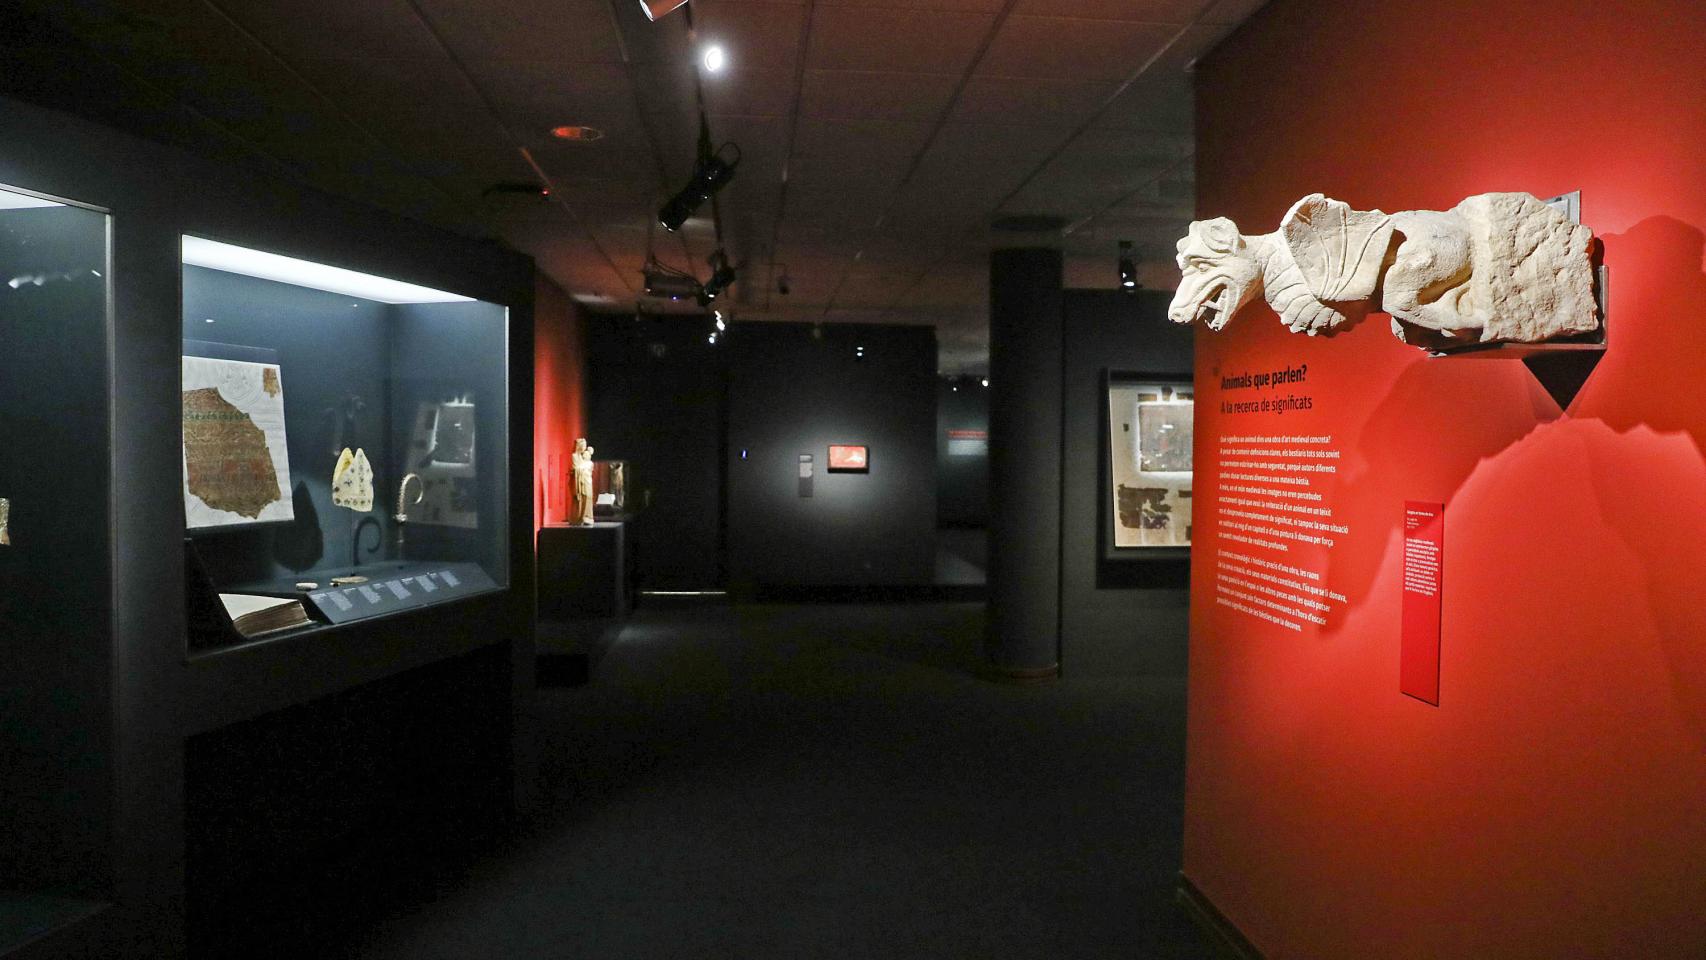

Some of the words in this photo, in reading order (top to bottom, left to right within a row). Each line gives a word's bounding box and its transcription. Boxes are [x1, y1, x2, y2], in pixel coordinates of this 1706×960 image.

[1221, 372, 1252, 390] Animals
[1254, 374, 1270, 390] que
[1272, 364, 1307, 389] parlen?
[1221, 402, 1225, 414] A
[1226, 401, 1233, 413] la
[1234, 400, 1259, 413] recerca
[1261, 398, 1270, 412] de
[1272, 394, 1313, 414] significats
[1291, 435, 1310, 444] medieval
[1310, 435, 1331, 444] concreta?
[1289, 448, 1307, 457] bestiaris
[1307, 448, 1316, 457] tots
[1316, 449, 1326, 458] sols
[1326, 449, 1340, 458] sovint
[1287, 462, 1301, 472] perquè
[1302, 462, 1315, 472] autors
[1316, 463, 1336, 473] diferents
[1298, 490, 1322, 500] percebudes
[1284, 503, 1293, 512] d'un
[1319, 522, 1330, 531] seva
[1330, 522, 1349, 534] situació
[1322, 536, 1334, 548] força
